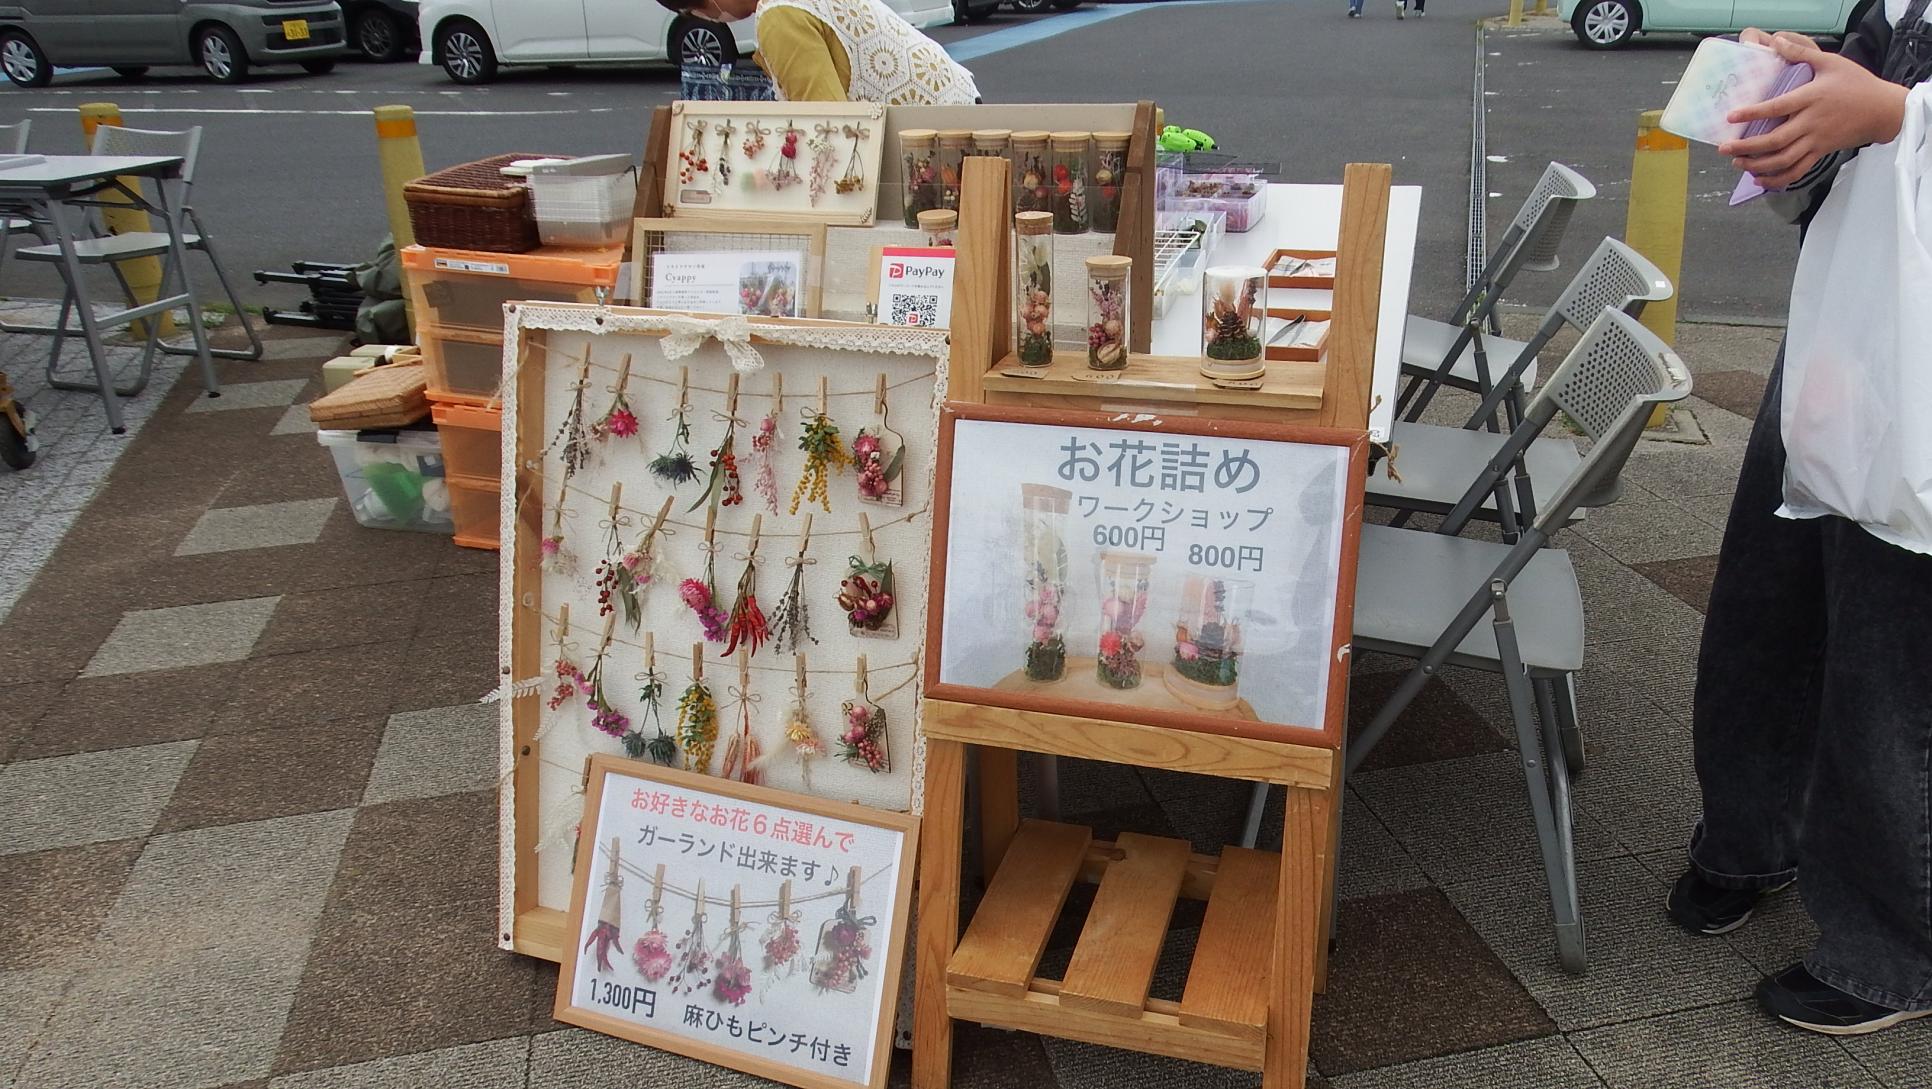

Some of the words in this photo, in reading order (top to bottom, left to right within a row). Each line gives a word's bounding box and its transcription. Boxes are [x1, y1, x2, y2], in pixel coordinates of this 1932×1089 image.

[664, 272, 697, 284] Cyappy
[905, 265, 945, 279] PayPay
[1057, 436, 1261, 494] お花詰め
[1077, 494, 1274, 532] ワークショップ
[1092, 524, 1166, 552] 600円
[1188, 542, 1265, 572] 800円
[630, 787, 855, 853] お好きなお花6点選んで
[589, 977, 657, 1018] 1,300円
[683, 1002, 852, 1067] 麻ひもピンチ付き
